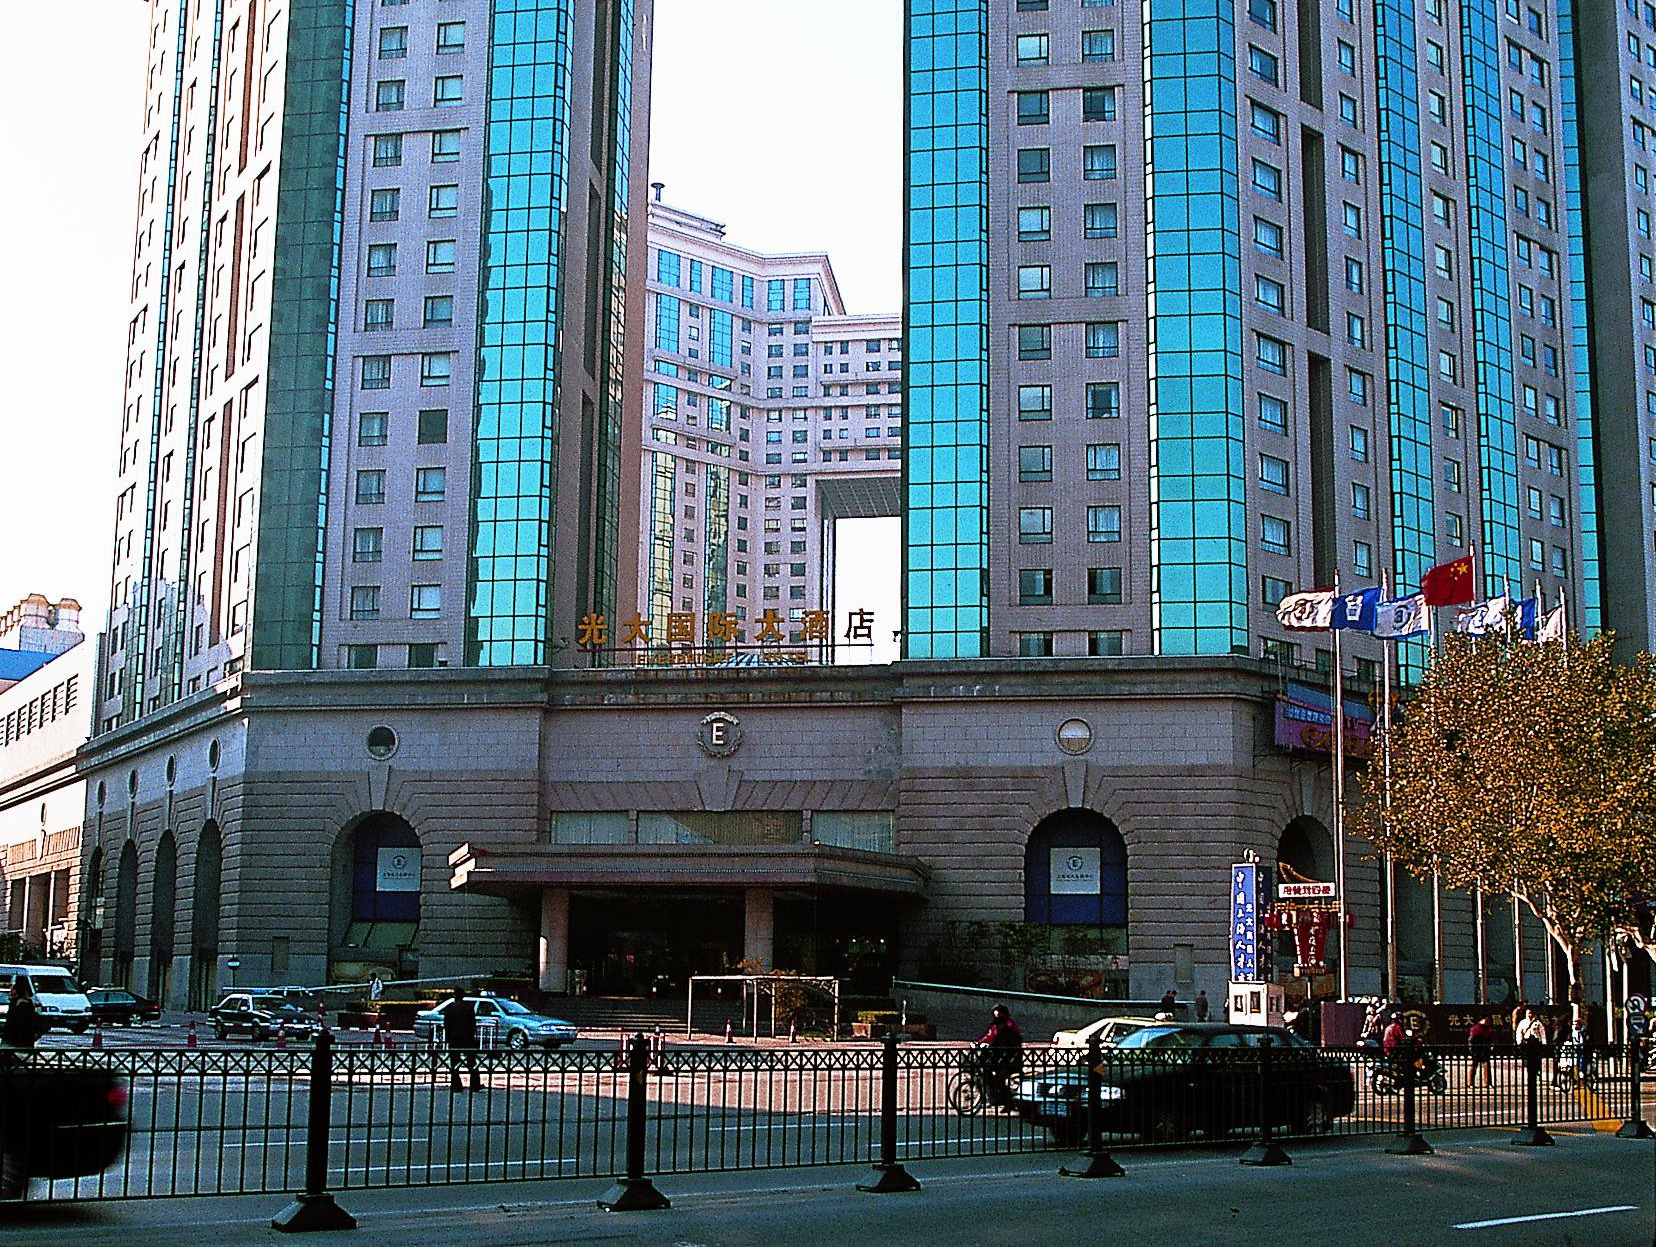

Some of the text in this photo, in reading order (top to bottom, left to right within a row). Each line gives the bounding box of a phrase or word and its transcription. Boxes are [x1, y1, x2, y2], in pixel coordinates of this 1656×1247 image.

[577, 608, 875, 644] 光大国际大酒店
[712, 722, 724, 744] E
